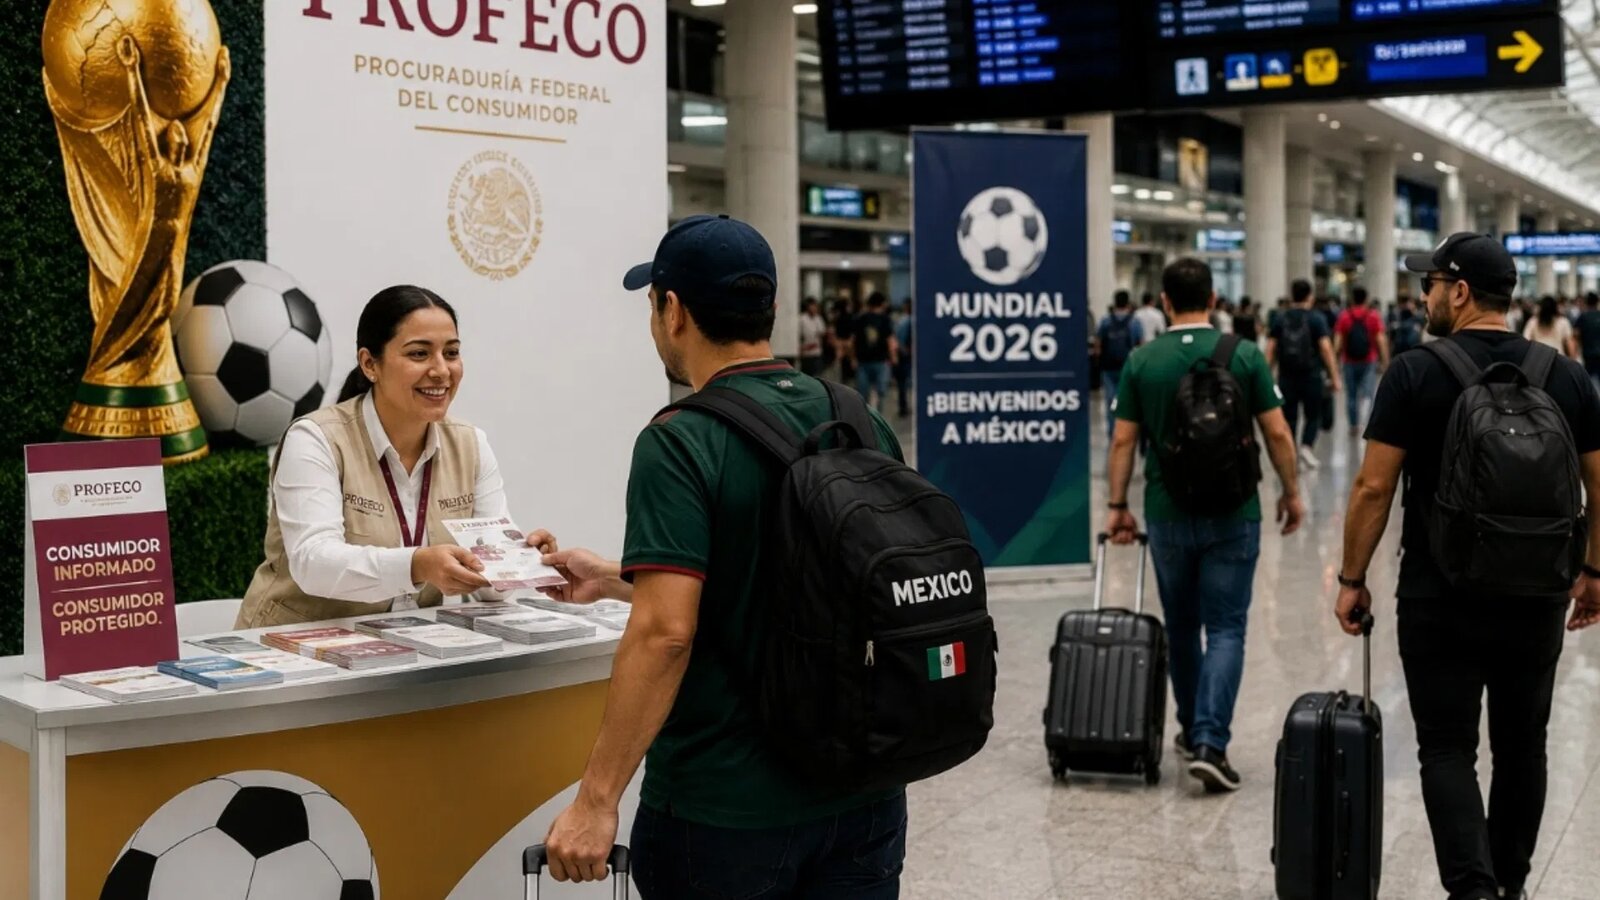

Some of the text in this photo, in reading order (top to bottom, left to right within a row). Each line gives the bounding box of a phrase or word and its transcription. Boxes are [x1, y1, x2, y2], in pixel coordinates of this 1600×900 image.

[302, 0, 647, 65] OFECO
[354, 54, 612, 104] PROCURADURÍA FEDERAL
[398, 89, 579, 125] DEL CONSUMIDOR
[935, 292, 1071, 318] MUNDIAL
[950, 323, 1058, 361] 2026
[927, 390, 1080, 417] ¡BIENVENIDOS
[941, 415, 1066, 444] A MÉXICO!
[74, 480, 142, 496] PROFECO
[46, 538, 160, 561] CONSUMIDOR
[54, 557, 156, 581] INFORMADO
[891, 569, 973, 607] MEXICO
[52, 592, 164, 617] CONSUMIDOR
[60, 610, 163, 636] PROTEGIDO.
